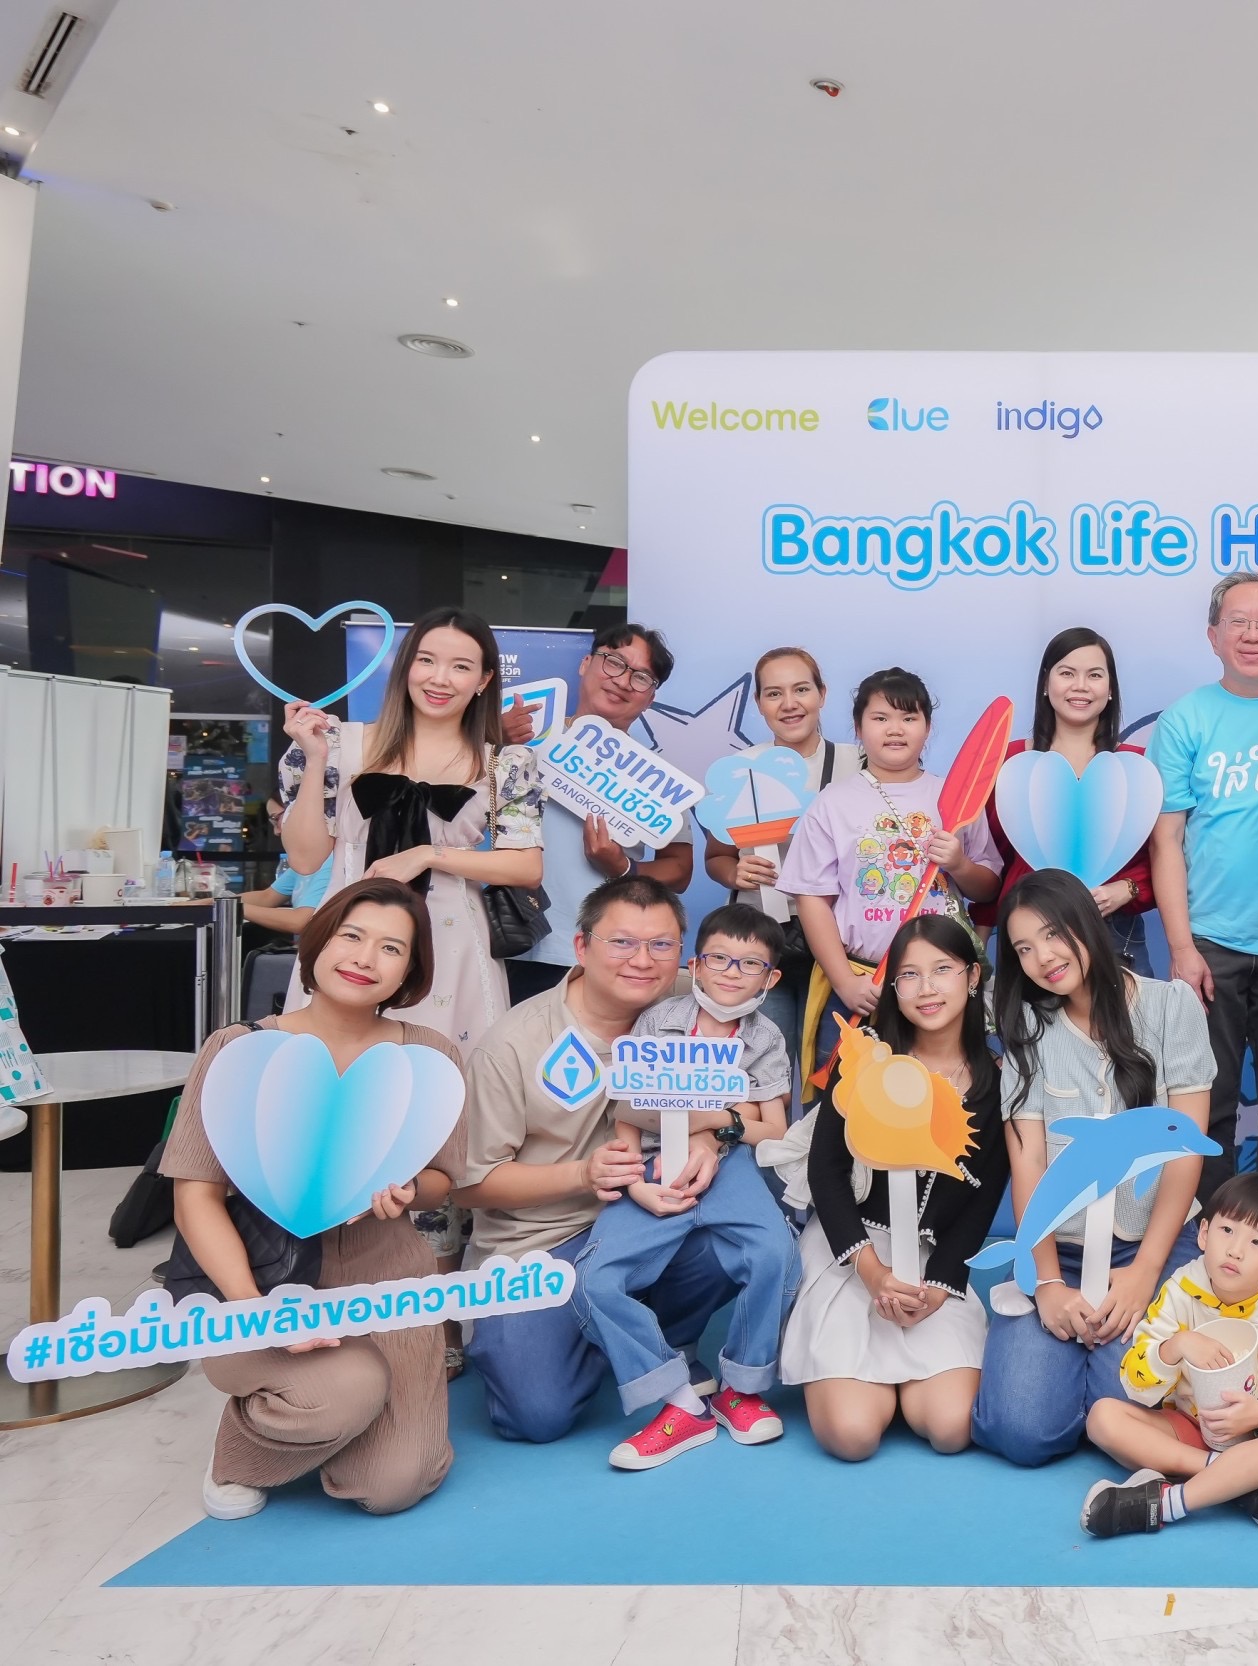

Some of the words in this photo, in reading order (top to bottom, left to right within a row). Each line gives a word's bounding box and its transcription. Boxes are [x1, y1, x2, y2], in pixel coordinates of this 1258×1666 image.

[651, 401, 820, 431] Welcome
[997, 399, 1103, 439] indigo
[770, 509, 1051, 582] Bangkok
[1078, 510, 1189, 566] Life
[548, 743, 673, 835] ประกันชีวิต
[574, 723, 694, 806] กรุงเทพ
[551, 777, 610, 822] BANGKOK
[608, 816, 636, 838] LIFE
[864, 907, 895, 921] CRY
[611, 1065, 744, 1093] ประกันชีวิต
[617, 1040, 739, 1071] กรุงเทพ
[633, 1098, 693, 1109] BANGKOK
[697, 1099, 722, 1109] LIFE
[24, 1263, 565, 1369] #เชื่อมั่นในพลังของความใส่ใจ
